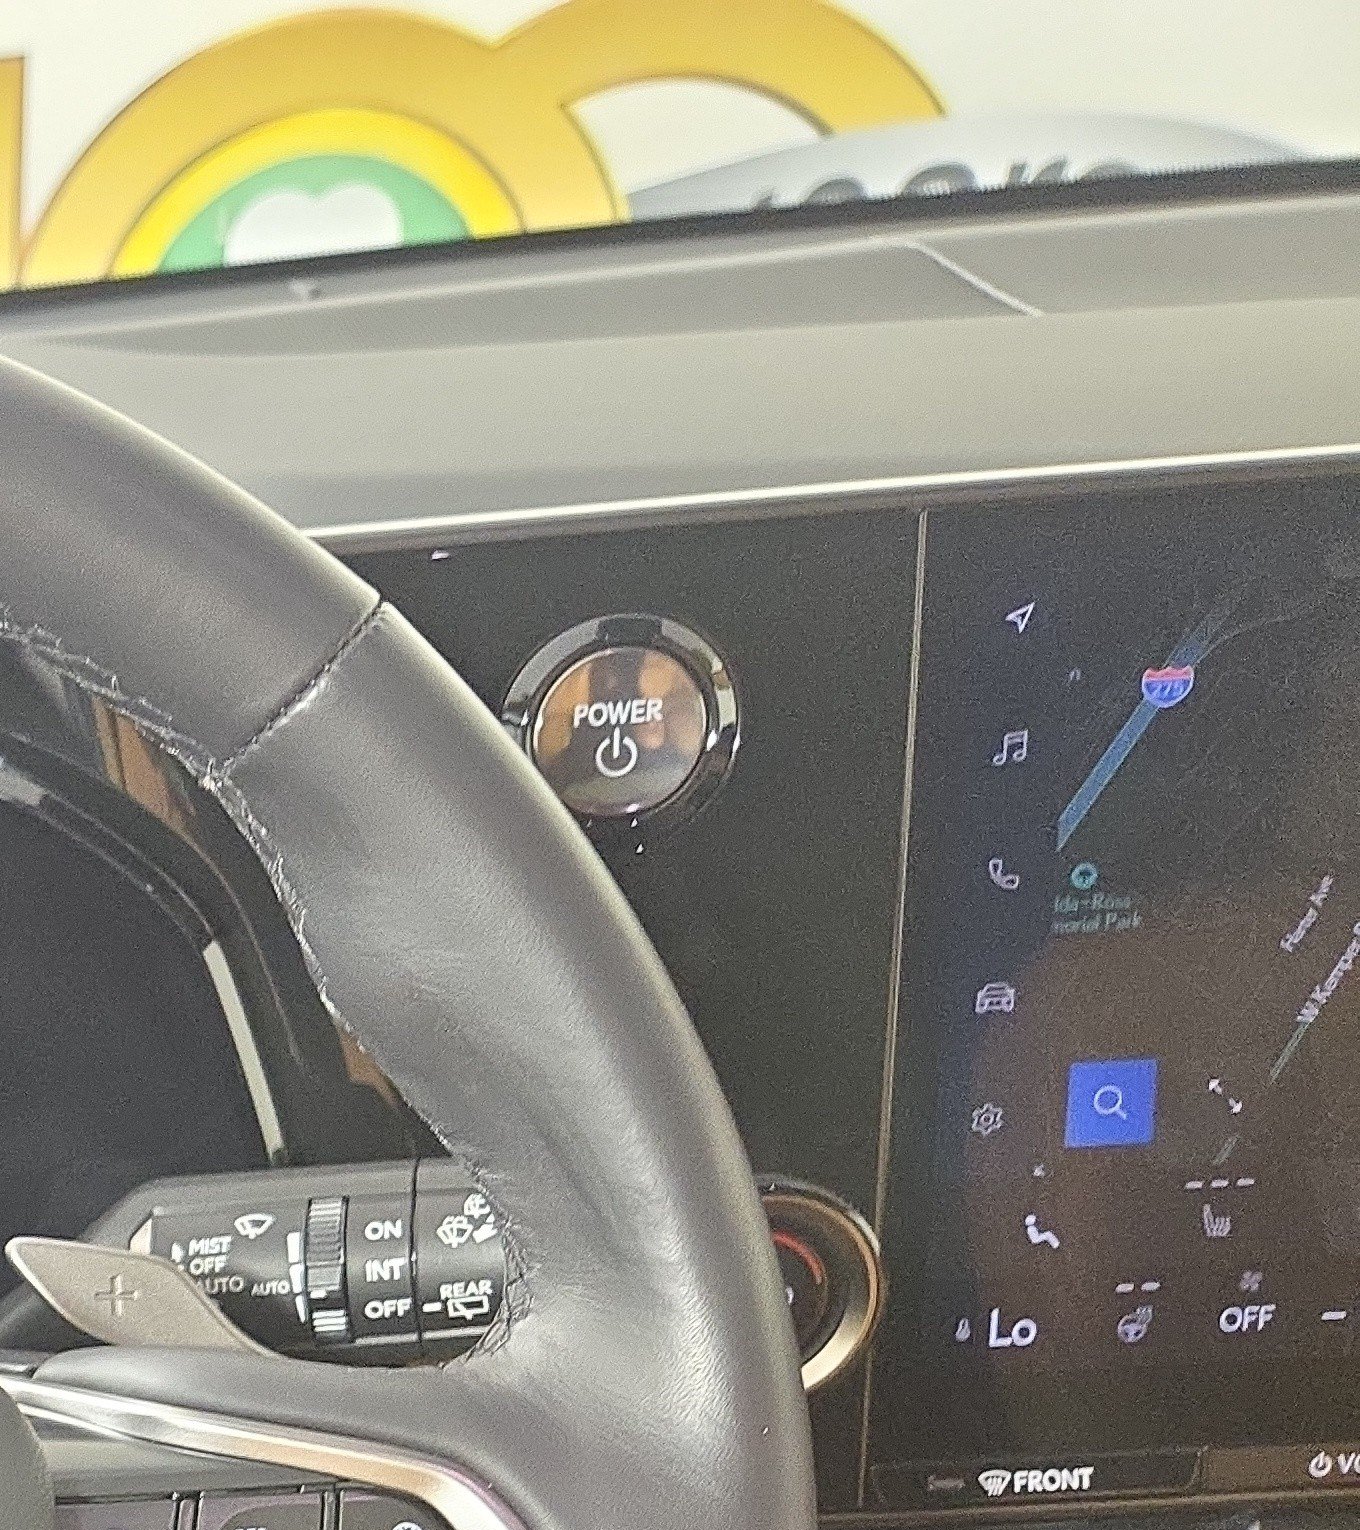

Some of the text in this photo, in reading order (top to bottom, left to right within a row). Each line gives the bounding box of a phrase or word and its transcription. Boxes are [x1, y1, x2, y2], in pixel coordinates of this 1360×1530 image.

[573, 698, 664, 728] POWER
[364, 1219, 402, 1241] ON
[188, 1235, 232, 1256] MIST
[189, 1255, 226, 1275] OFF
[365, 1257, 406, 1282] INT
[250, 1280, 290, 1297] AUTO
[440, 1280, 493, 1300] REAR
[364, 1297, 412, 1319] OFF
[1219, 1304, 1276, 1332] OFF
[989, 1307, 1037, 1347] Lo
[1013, 1466, 1094, 1494] FRONT
